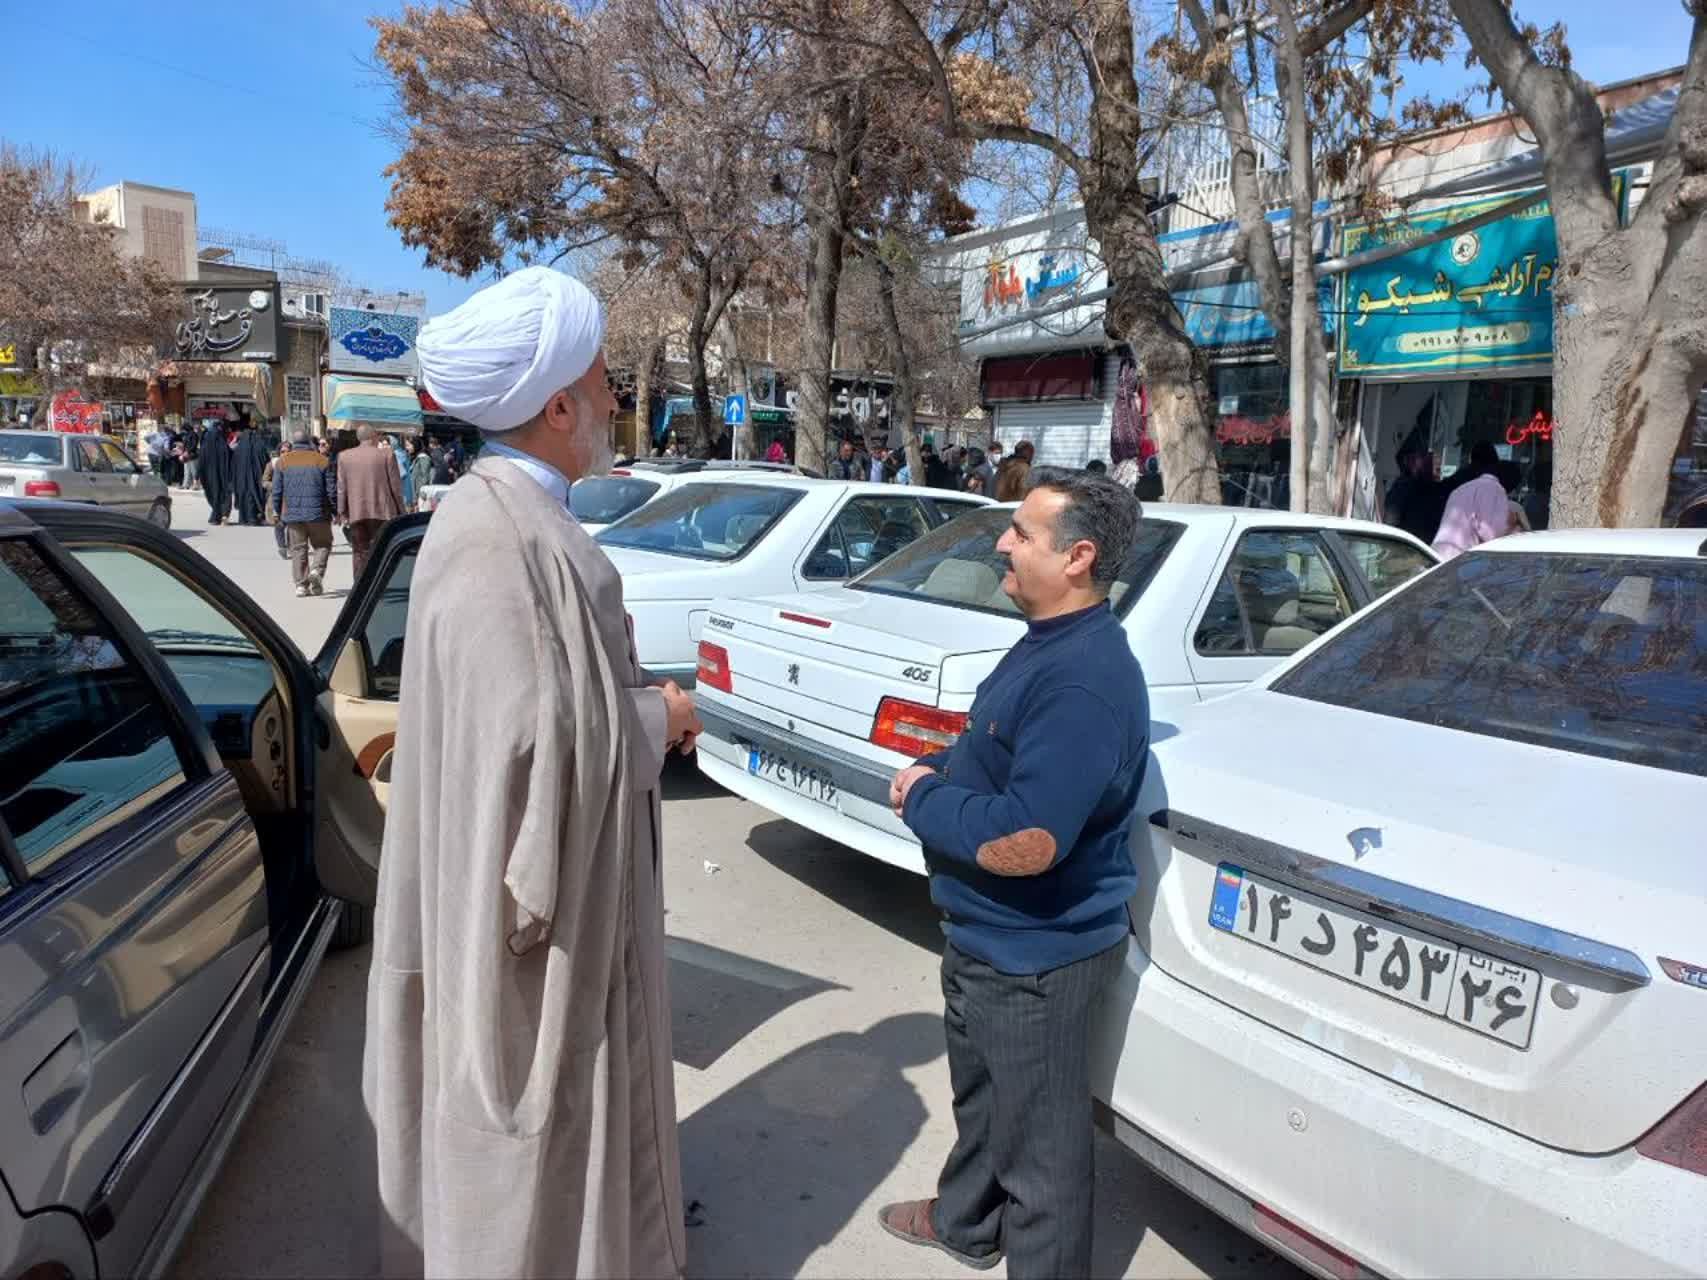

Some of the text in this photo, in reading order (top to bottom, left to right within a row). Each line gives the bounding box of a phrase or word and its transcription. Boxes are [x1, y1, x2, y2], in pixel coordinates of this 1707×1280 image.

[1353, 270, 1453, 328] شیکو
[1456, 251, 1537, 308] آرایشی
[902, 666, 932, 682] 405
[1470, 955, 1527, 984] ایران
[1460, 970, 1528, 1032] ۲۶
